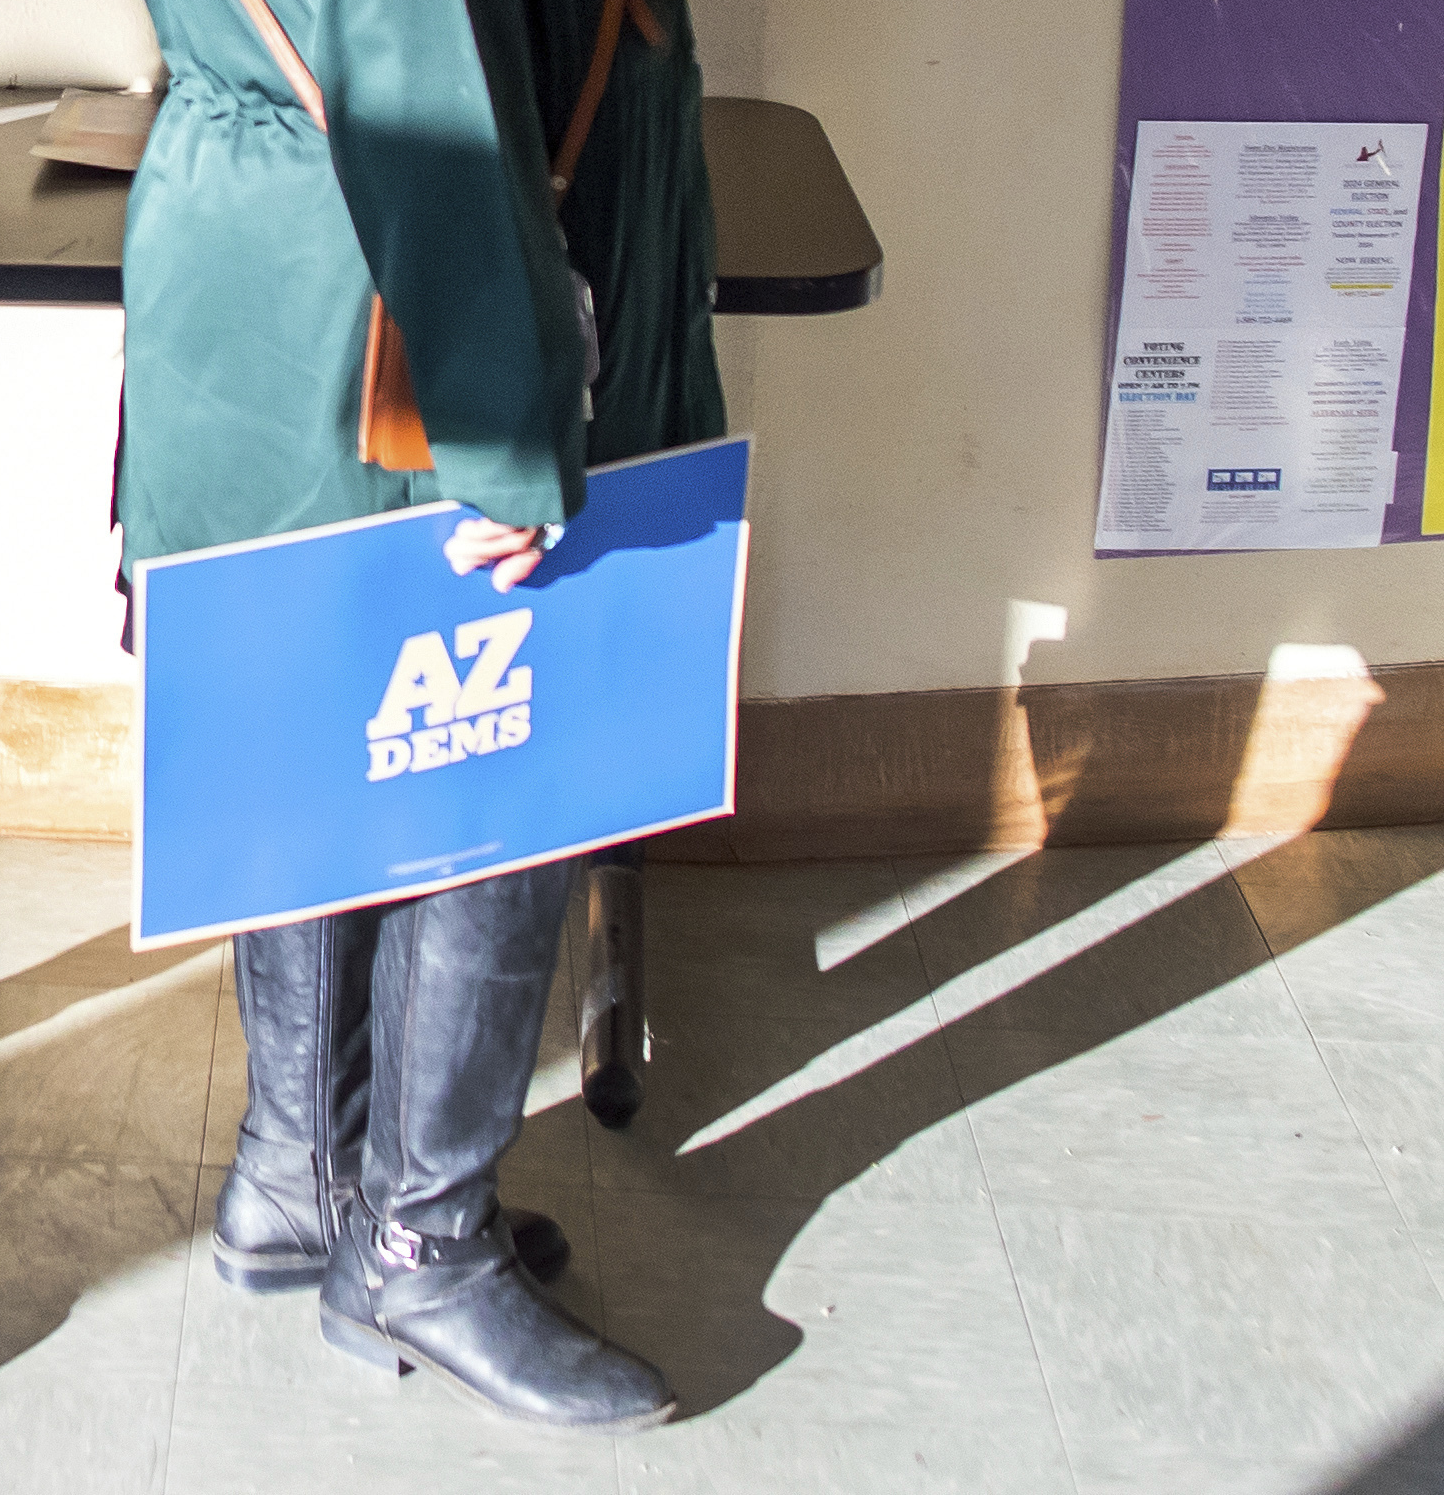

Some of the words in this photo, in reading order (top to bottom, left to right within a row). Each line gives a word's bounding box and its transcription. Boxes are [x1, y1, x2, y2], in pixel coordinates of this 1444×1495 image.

[1124, 356, 1201, 365] CONVENIENCE
[1143, 342, 1184, 352] VOTING
[366, 607, 533, 741] AZ
[366, 703, 532, 783] DEMS
